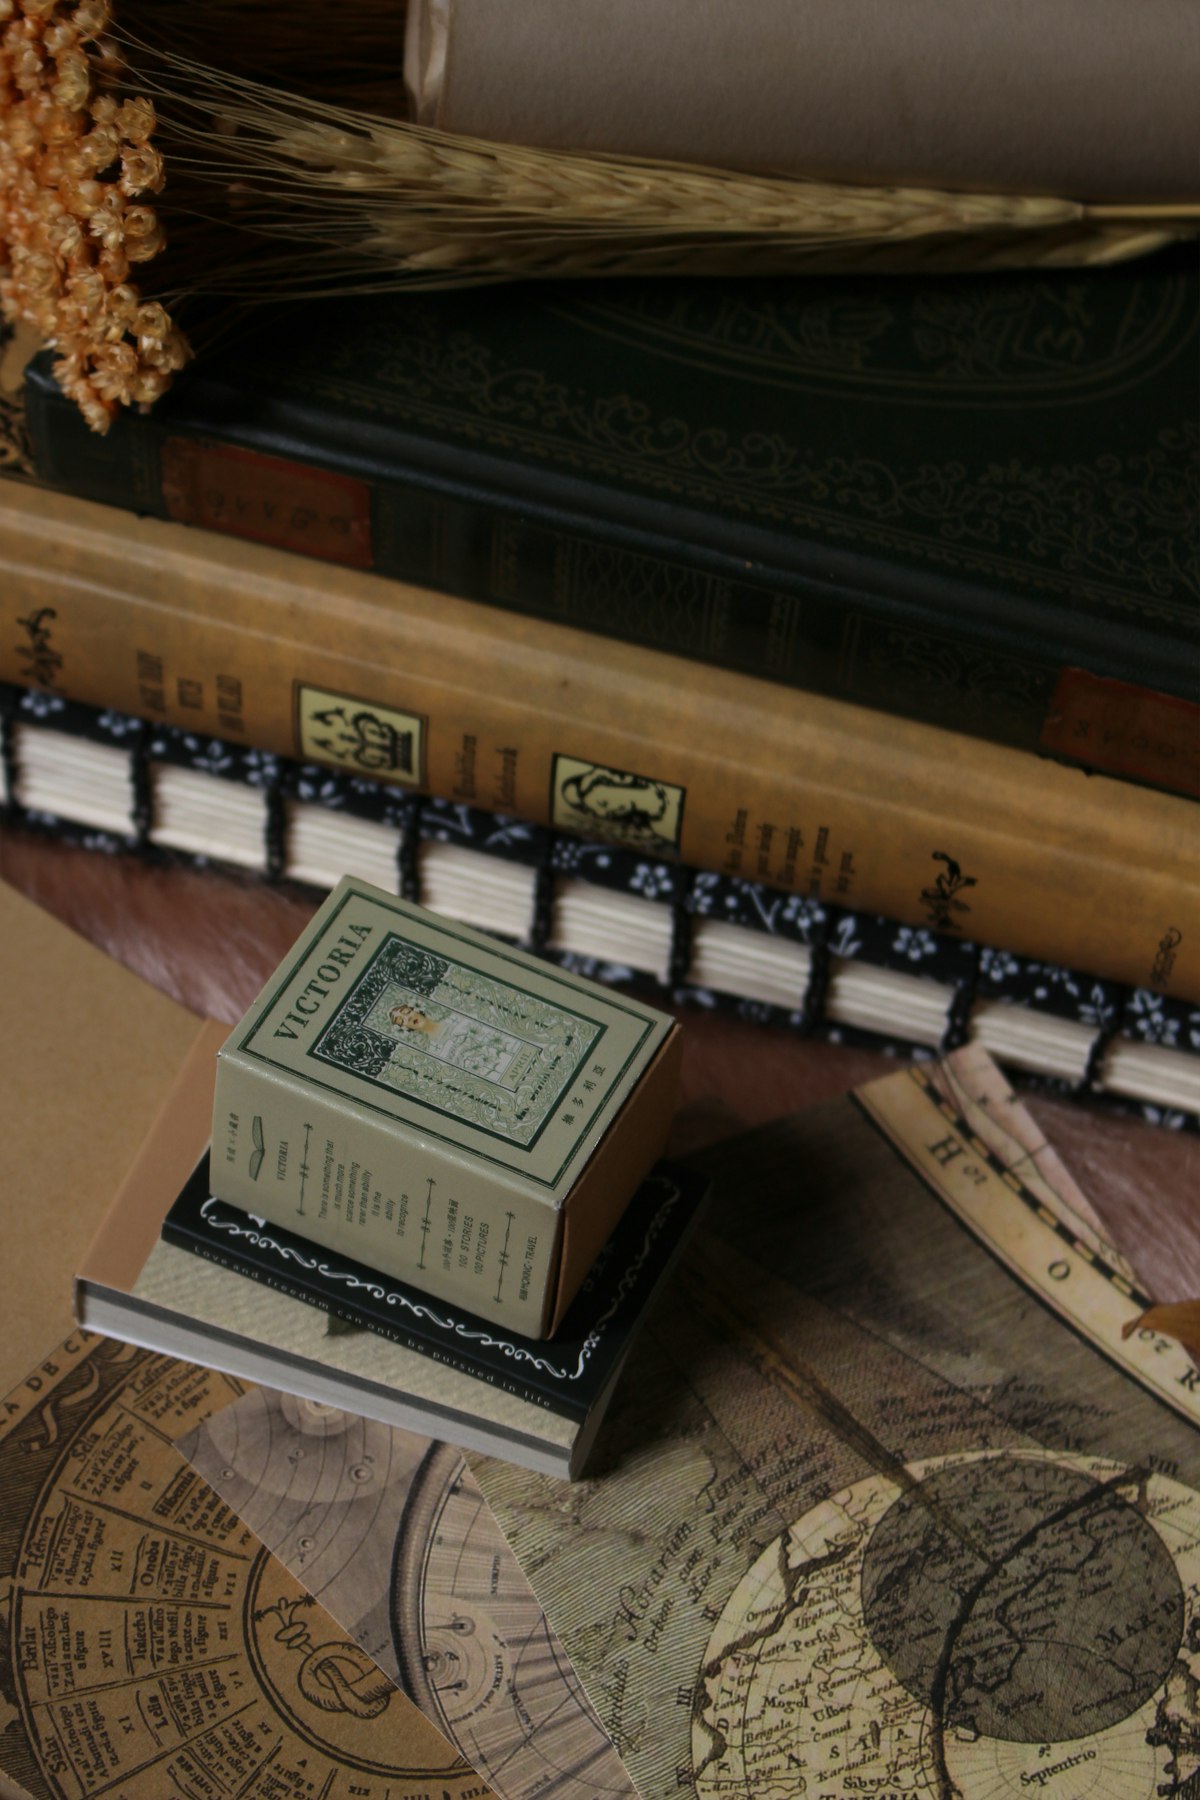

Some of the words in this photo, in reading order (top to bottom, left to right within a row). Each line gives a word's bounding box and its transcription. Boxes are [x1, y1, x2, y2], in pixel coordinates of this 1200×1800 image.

[273, 922, 373, 1043] VICTORIA
[507, 1048, 531, 1081] APRIL
[276, 1140, 288, 1180] VICTORIA
[320, 1154, 334, 1193] something
[459, 1214, 474, 1252] STORIES
[475, 1221, 490, 1262] PICTURES
[231, 1261, 260, 1279] and
[265, 1276, 330, 1310] freedom
[335, 1308, 363, 1325] can
[365, 1320, 400, 1342] only
[405, 1338, 425, 1352] be
[431, 1350, 495, 1383] pursued
[762, 1695, 810, 1714] Mogol
[1020, 1749, 1098, 1787] Septentrio
